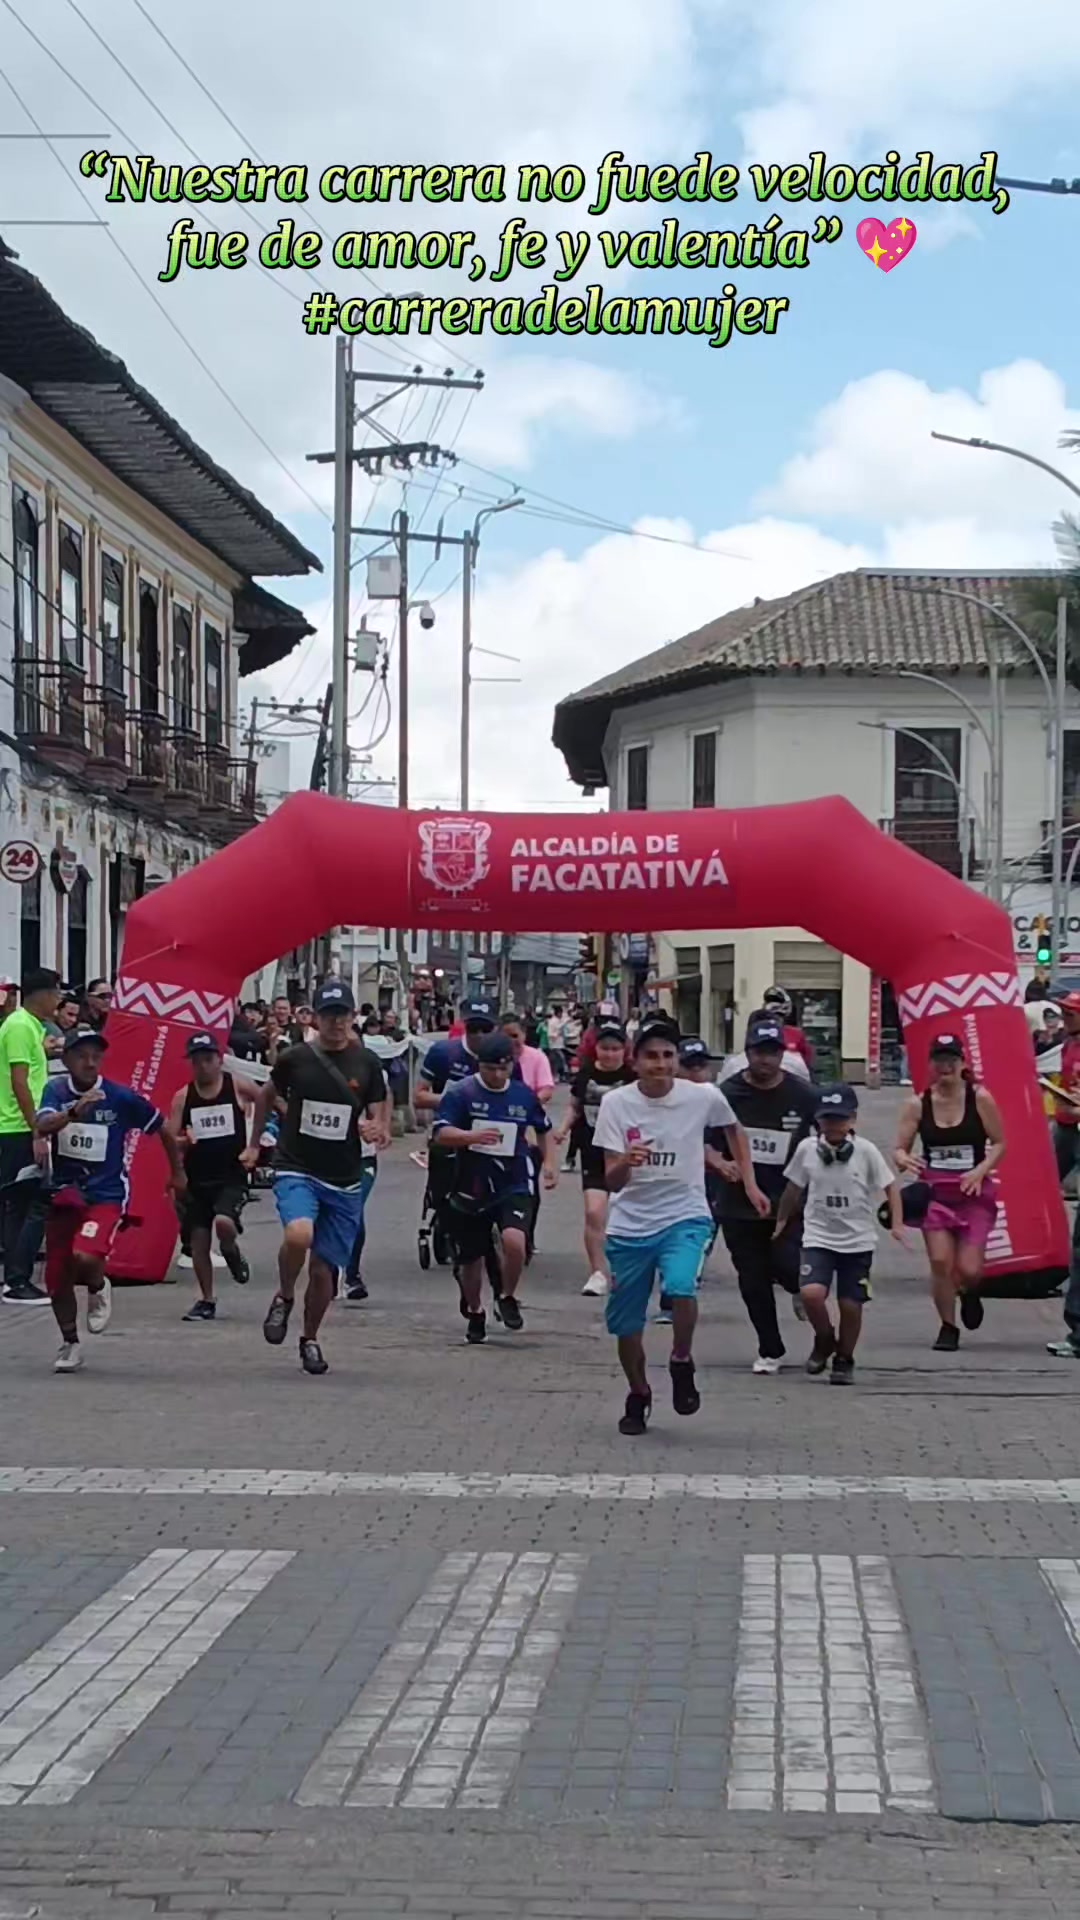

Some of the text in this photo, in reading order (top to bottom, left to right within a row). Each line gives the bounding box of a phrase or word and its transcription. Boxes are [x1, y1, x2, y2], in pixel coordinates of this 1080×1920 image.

[510, 832, 679, 857] ALCALDÍA DE
[6, 848, 35, 868] 24
[511, 850, 728, 892] FACATATIVÁ
[311, 1113, 340, 1128] 1258
[70, 1135, 93, 1149] 610
